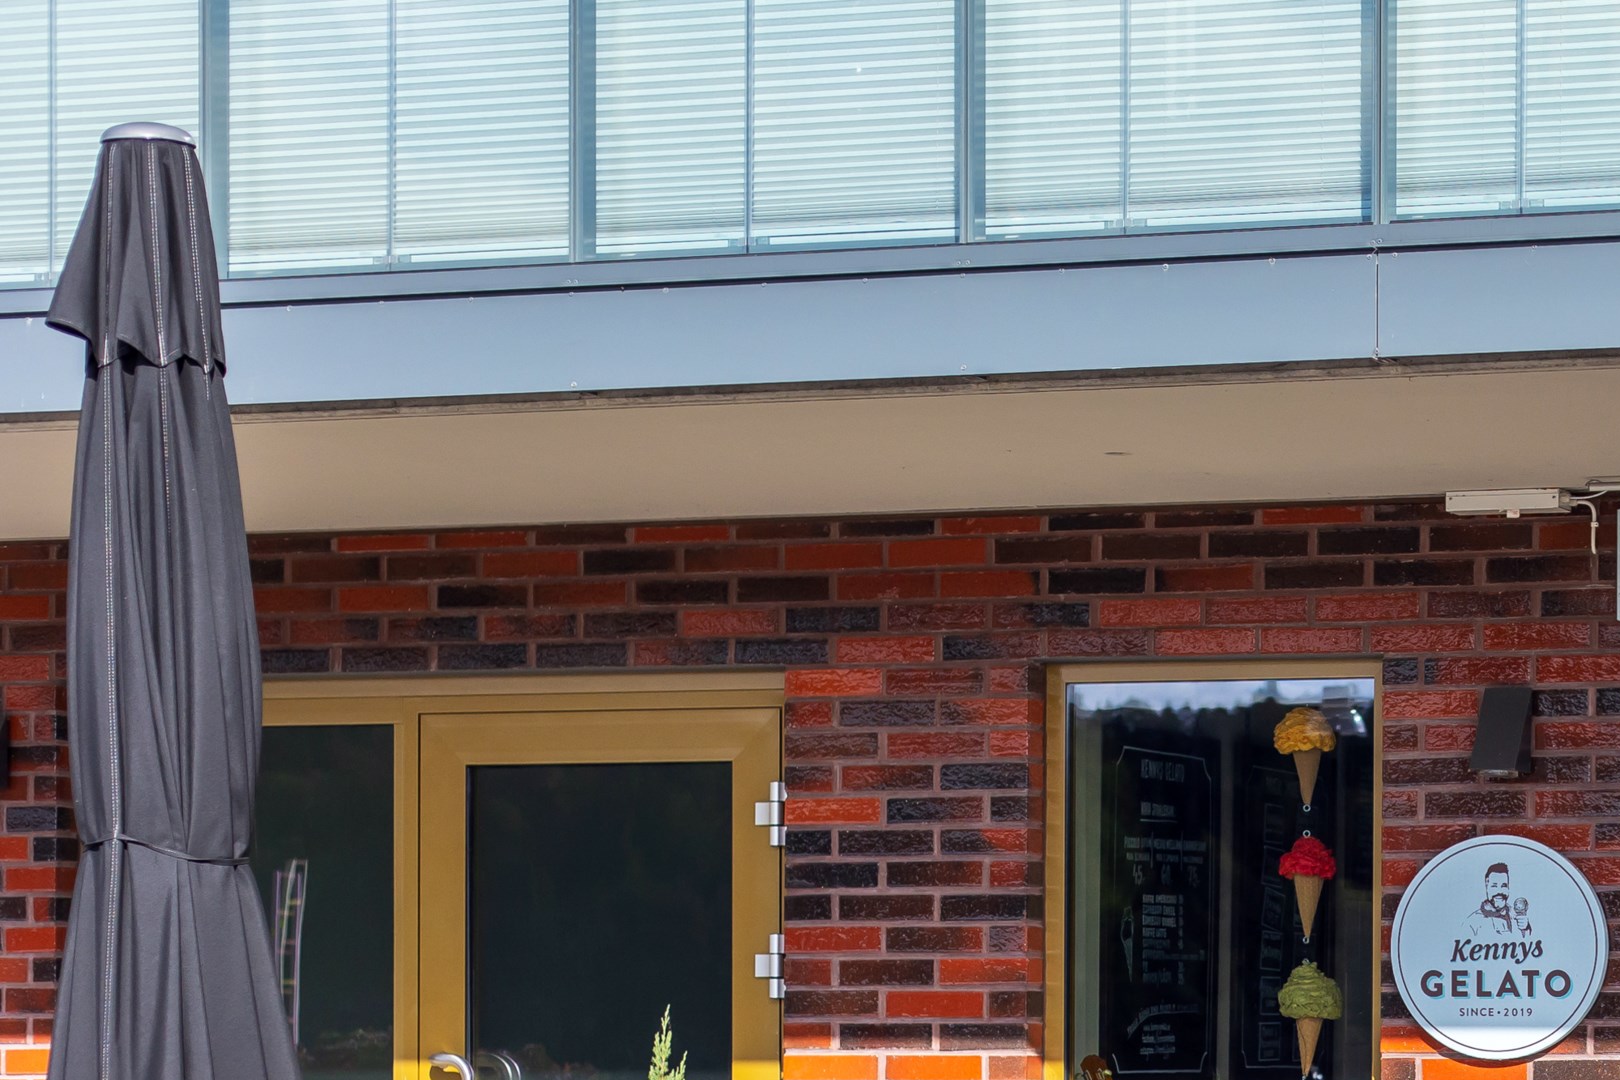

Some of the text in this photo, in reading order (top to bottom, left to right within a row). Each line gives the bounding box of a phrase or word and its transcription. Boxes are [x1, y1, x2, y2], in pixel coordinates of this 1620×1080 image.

[1450, 939, 1544, 965] Kennys
[1420, 969, 1573, 999] GELATO
[1459, 1007, 1533, 1017] SINCE 2019
